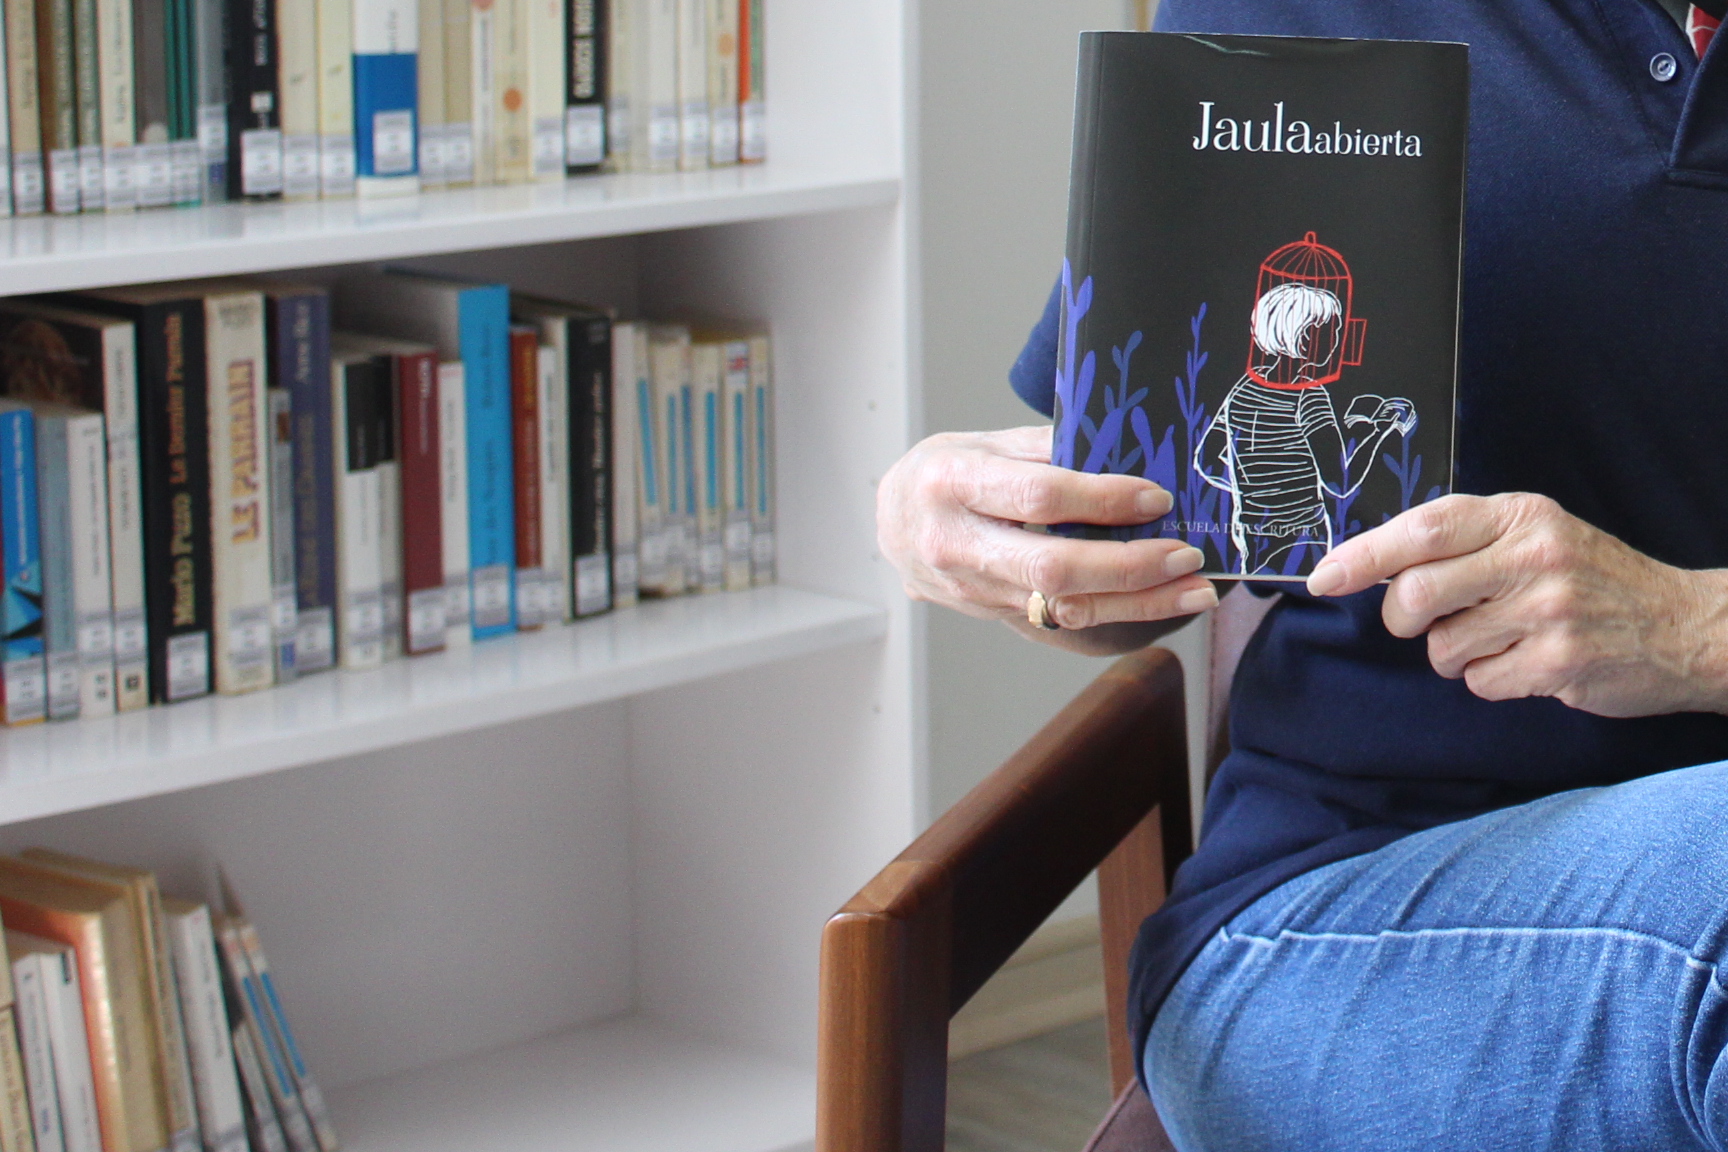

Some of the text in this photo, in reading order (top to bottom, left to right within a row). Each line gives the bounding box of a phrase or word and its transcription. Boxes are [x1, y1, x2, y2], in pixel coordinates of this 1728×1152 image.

[164, 313, 195, 626] Mario Puzo Le Dernier Parrain
[228, 359, 259, 544] LE PARRAIN
[1162, 520, 1220, 534] ESCUELA
[1244, 523, 1320, 537] ESCRITURA
